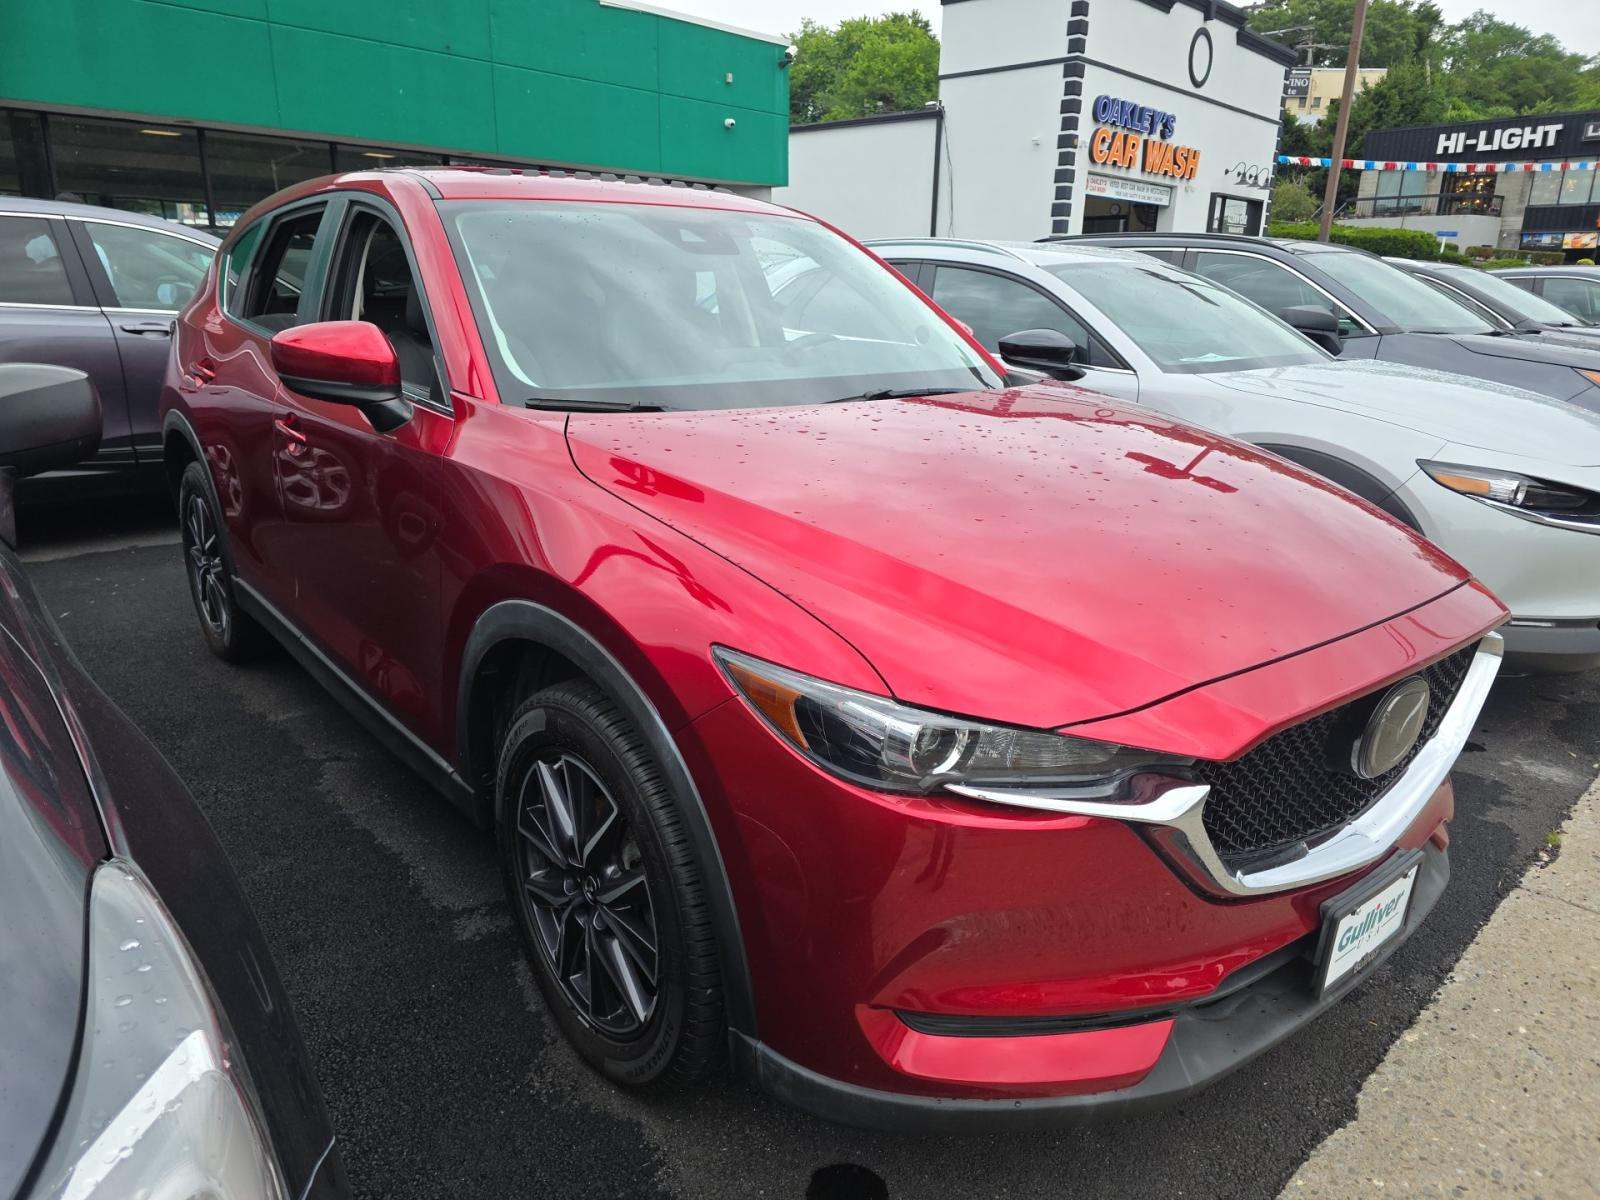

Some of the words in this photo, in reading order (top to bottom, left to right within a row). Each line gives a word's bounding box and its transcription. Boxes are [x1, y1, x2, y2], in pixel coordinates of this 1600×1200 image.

[1092, 95, 1177, 139] OAKLEY'S
[1436, 124, 1564, 155] HI-LIGHT
[1089, 127, 1141, 168] CAR
[1142, 139, 1201, 180] WASH
[1337, 890, 1404, 953] Gulliver
